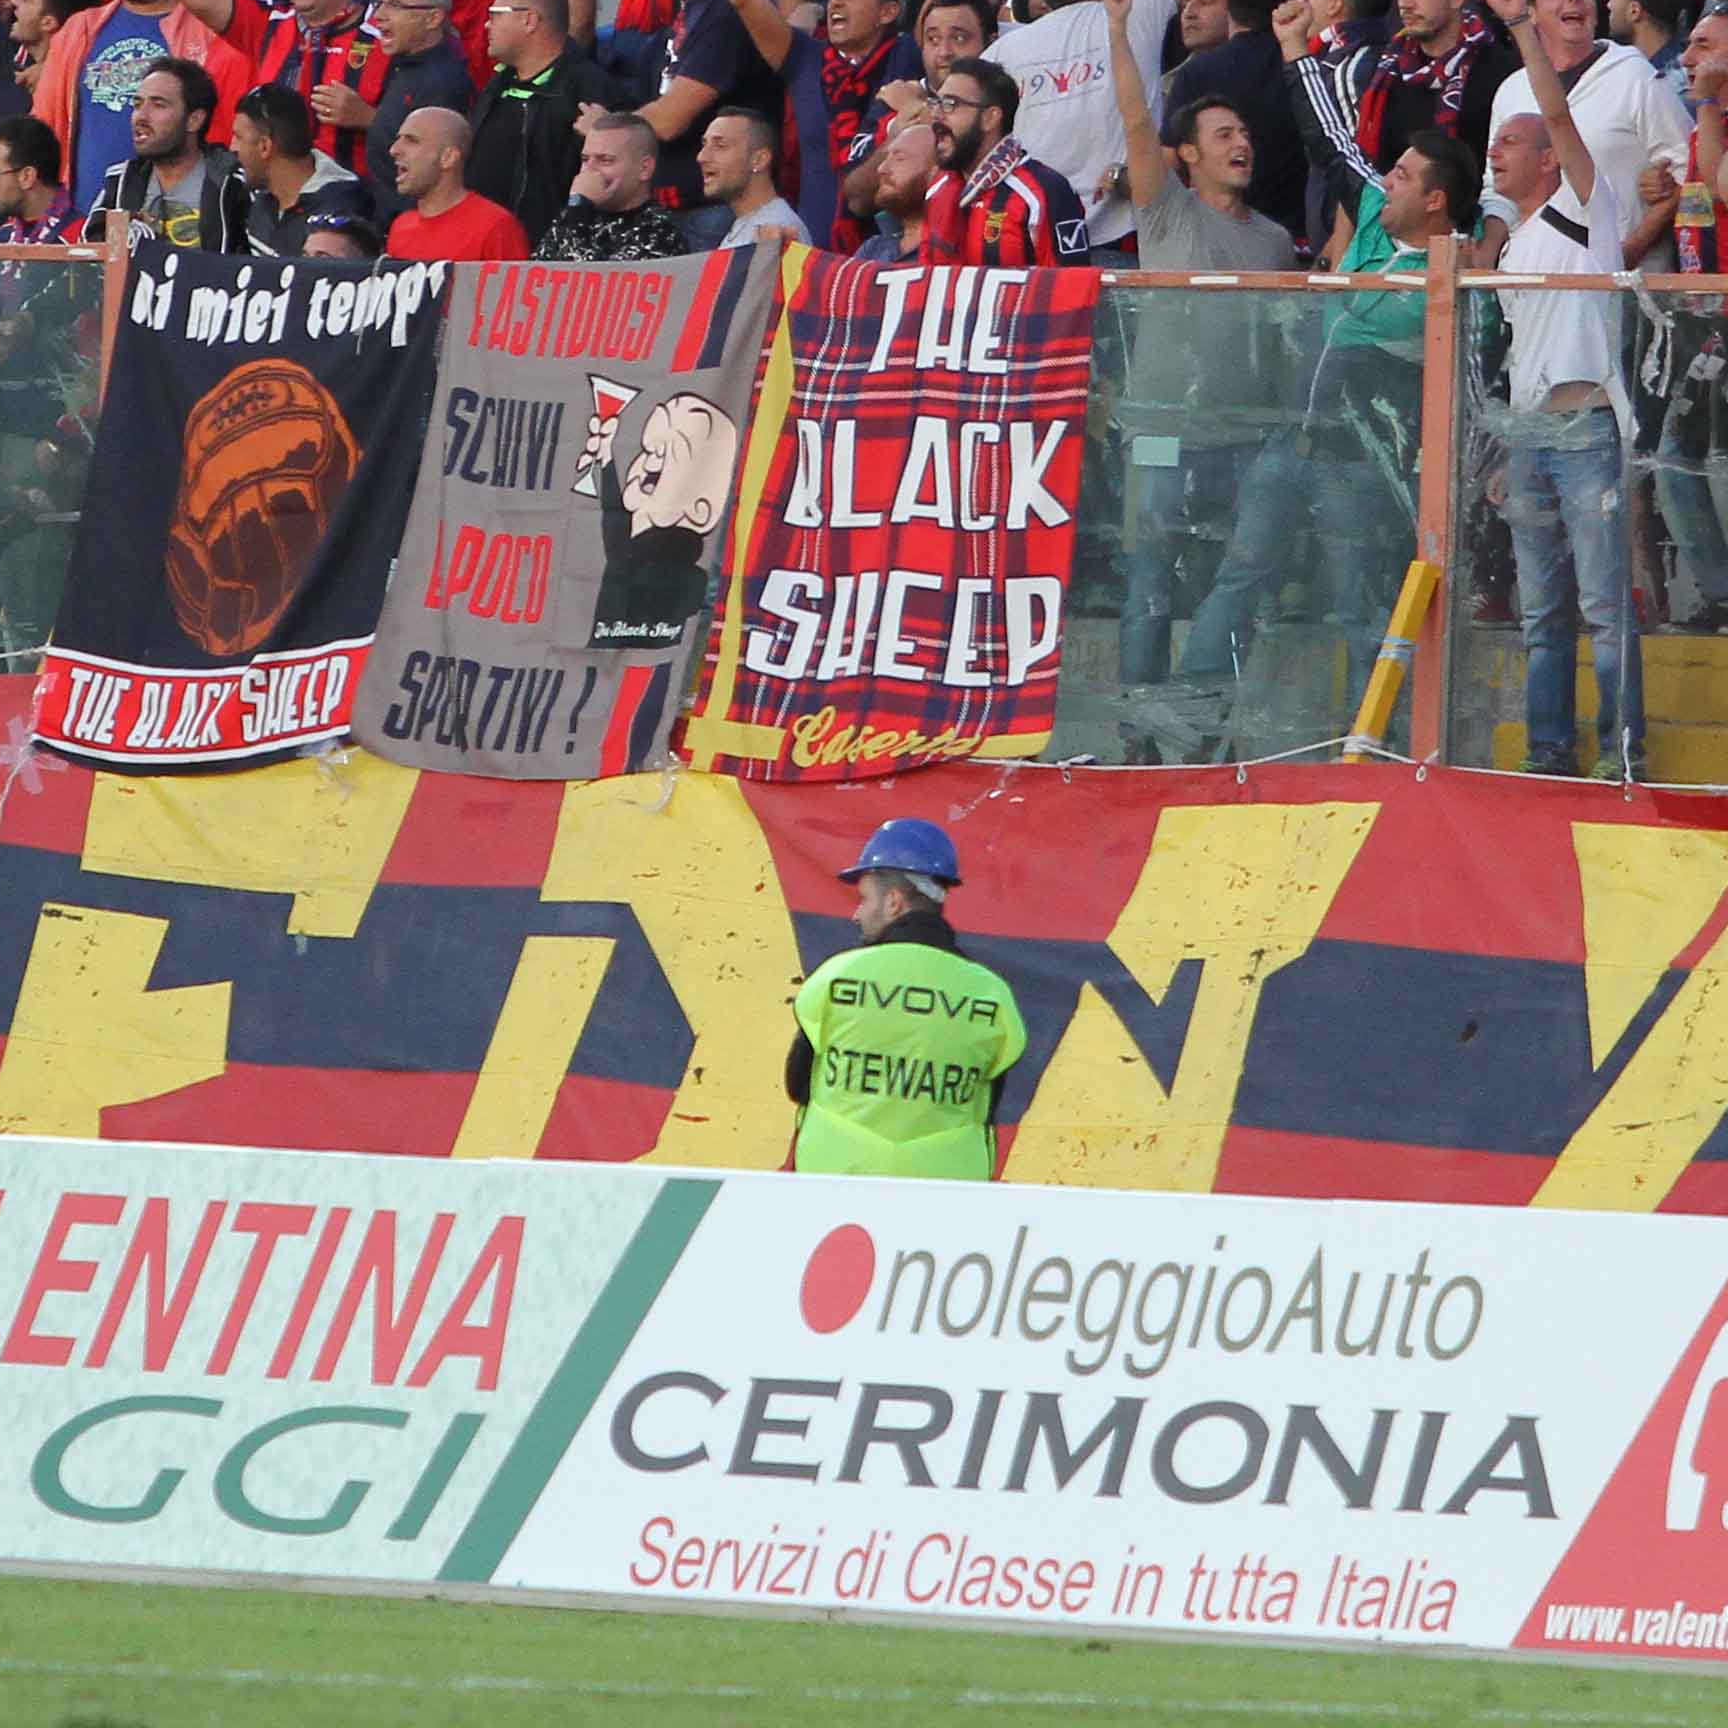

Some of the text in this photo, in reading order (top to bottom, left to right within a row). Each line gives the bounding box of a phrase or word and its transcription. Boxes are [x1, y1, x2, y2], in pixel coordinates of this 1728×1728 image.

[185, 263, 296, 347] miei
[868, 265, 1030, 374] THE
[782, 415, 1071, 531] BLACK
[744, 567, 1067, 688] SHEEP
[61, 654, 351, 750] THE BLACK SHEEP
[829, 976, 1000, 1027] GIVOVA
[824, 1045, 982, 1106] STEWARD
[609, 1370, 1558, 1519] CERIMONIA
[628, 1513, 818, 1597] Servizi
[834, 1527, 886, 1601] di
[905, 1531, 1097, 1614] Classe
[1111, 1545, 1165, 1620] in
[1315, 1551, 1459, 1635] Italia
